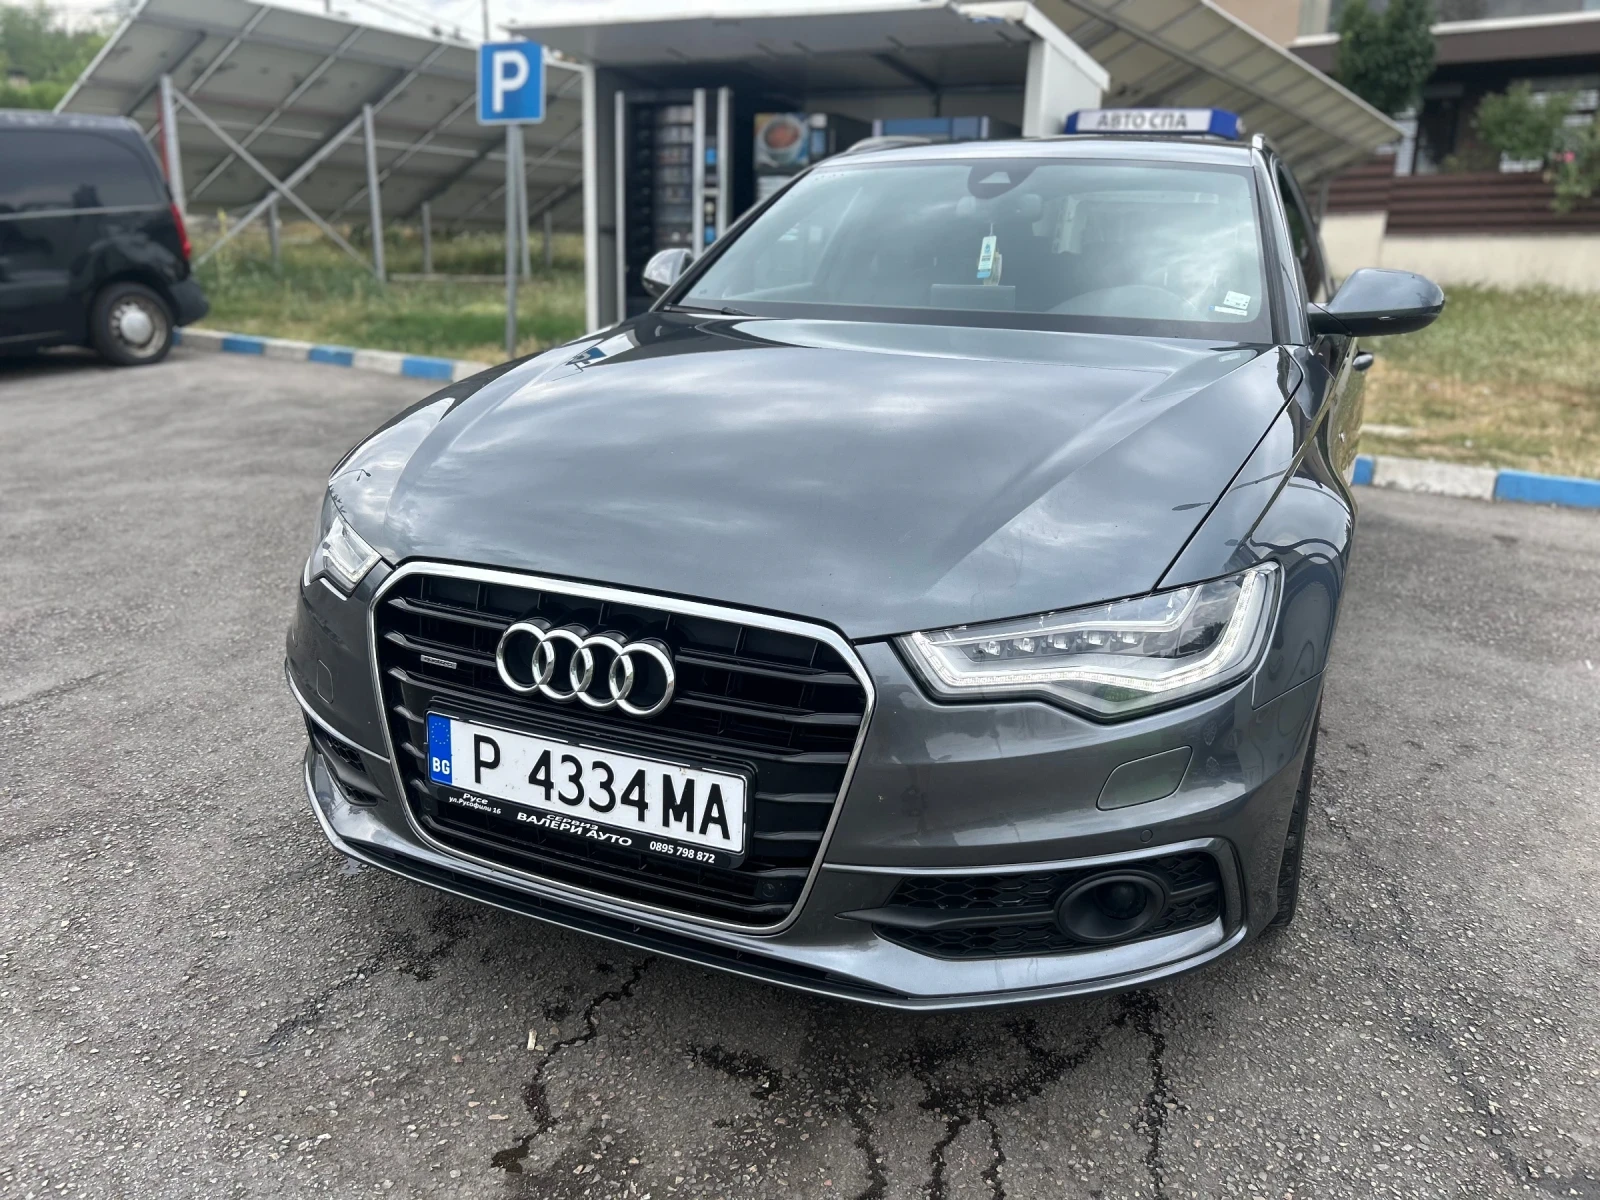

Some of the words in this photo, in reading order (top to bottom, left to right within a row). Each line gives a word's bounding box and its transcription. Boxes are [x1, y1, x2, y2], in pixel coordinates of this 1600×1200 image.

[492, 50, 530, 113] P
[1097, 112, 1146, 129] АВТО
[1148, 112, 1188, 129] СПА
[432, 757, 450, 775] BG
[473, 733, 501, 784] P
[462, 793, 489, 805] Русе
[492, 807, 502, 815] 16
[516, 812, 583, 835] ВАЛЕРИ
[586, 829, 633, 846] АУТО
[546, 814, 599, 831] СЕРВИЗ
[649, 841, 674, 854] 0895
[676, 847, 695, 859] 798
[696, 852, 716, 864] 872
